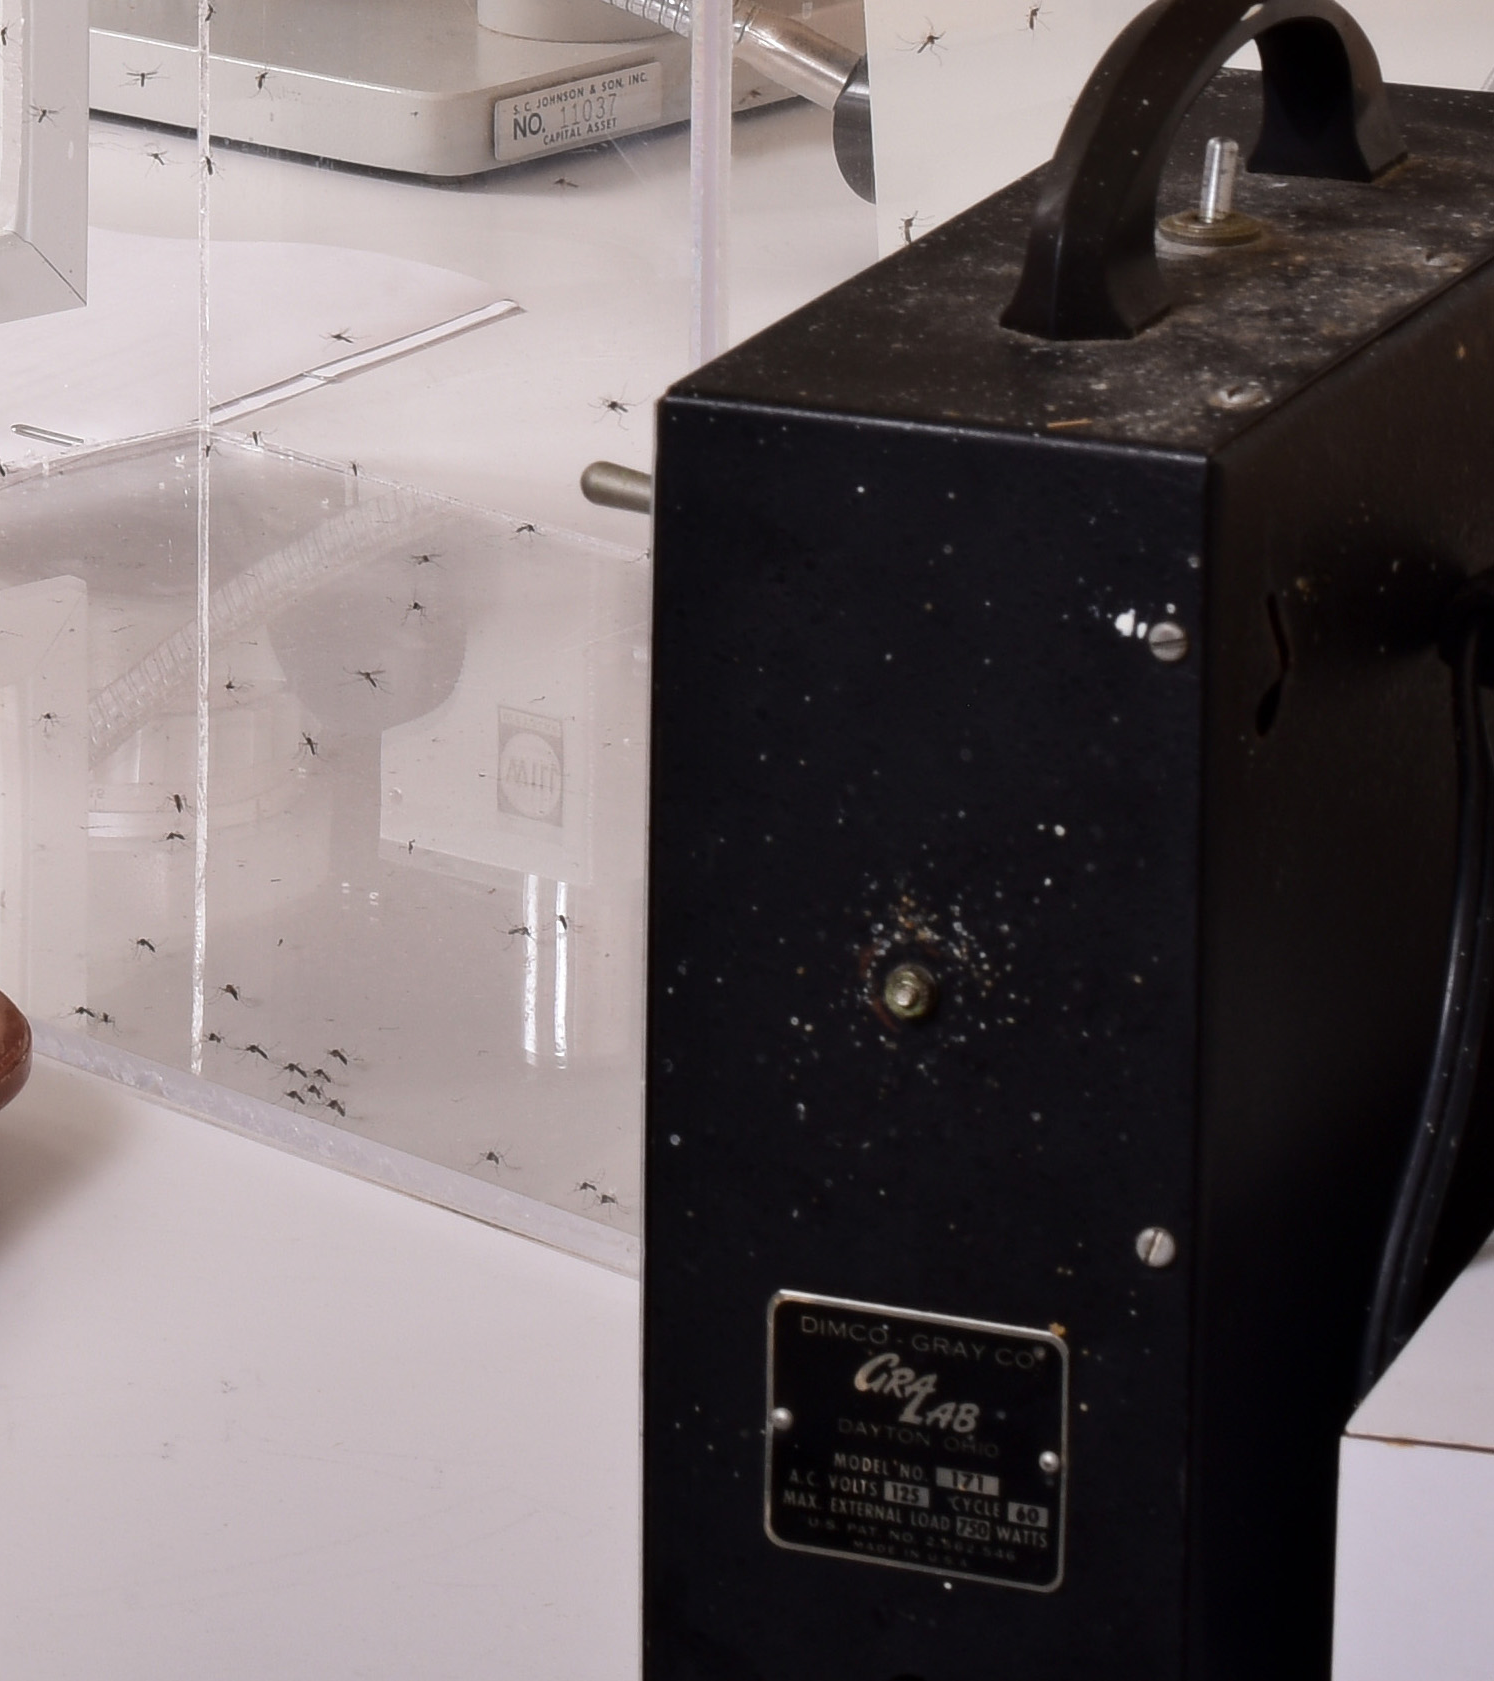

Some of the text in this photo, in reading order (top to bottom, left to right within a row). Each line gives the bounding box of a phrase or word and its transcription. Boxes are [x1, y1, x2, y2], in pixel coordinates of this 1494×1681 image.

[537, 86, 585, 110] JOHNSON
[589, 84, 596, 95] &
[628, 72, 648, 86] INC.
[513, 93, 618, 140] NO. 11037
[543, 117, 618, 145] CAPITAL ASSET
[800, 1316, 889, 1345] DIMCO
[911, 1334, 986, 1364] GRAY
[839, 1419, 999, 1459] DAYTON OHIO
[834, 1452, 889, 1476] MODEL
[829, 1473, 878, 1496] VOLTS
[951, 1495, 1001, 1517] CYCLE
[830, 1497, 902, 1524] EXTERNAL
[910, 1511, 951, 1531] LOAD
[996, 1523, 1048, 1548] WATTS
